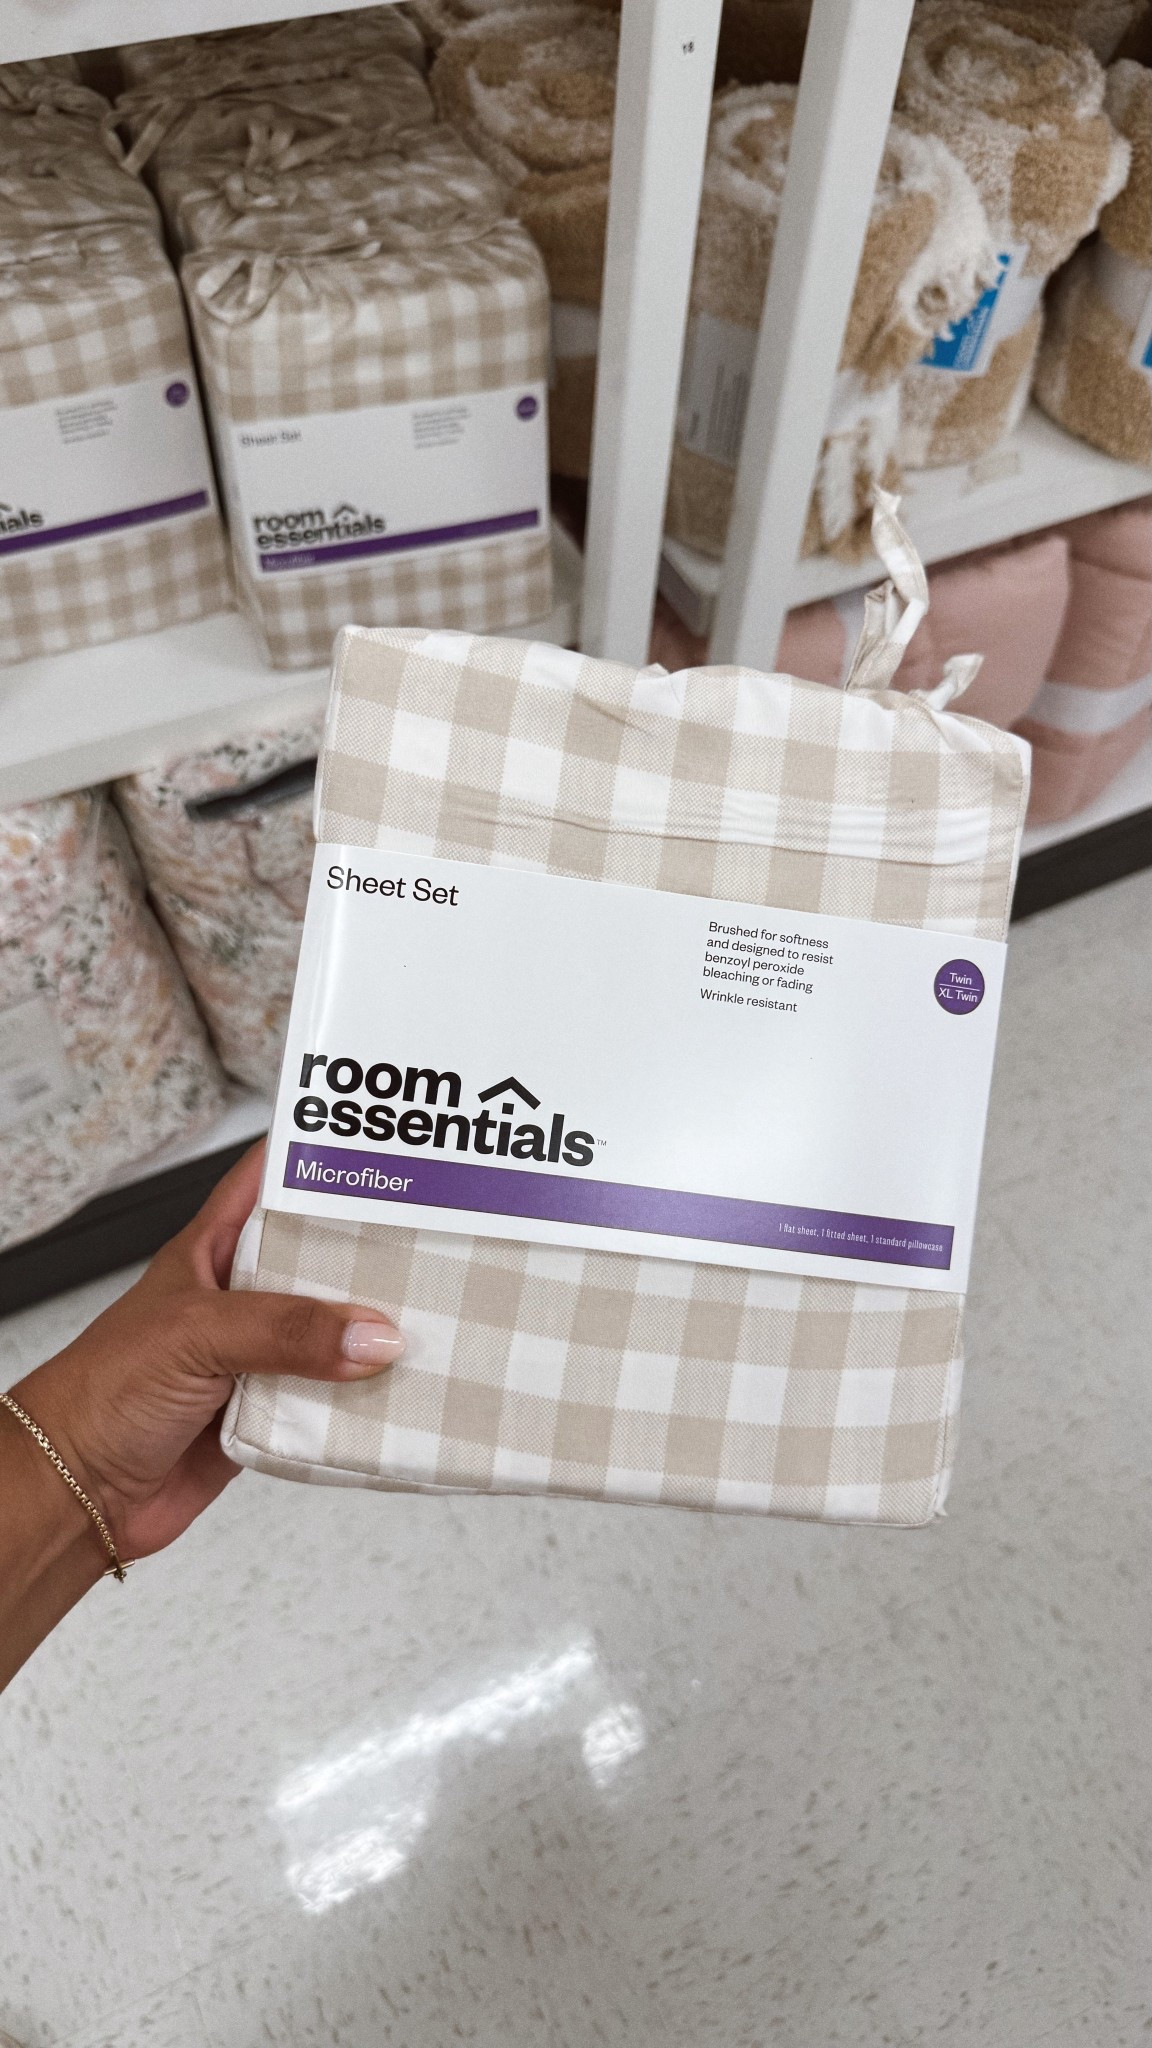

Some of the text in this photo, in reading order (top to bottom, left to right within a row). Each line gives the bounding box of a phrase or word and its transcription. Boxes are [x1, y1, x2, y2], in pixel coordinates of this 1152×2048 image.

[254, 509, 325, 533] room
[257, 514, 386, 549] essentials
[326, 866, 459, 906] Sheet Set
[708, 921, 829, 949] Brushed for softness
[704, 951, 805, 976] benzoyl peroxide
[706, 938, 834, 965] and designed to resist
[702, 966, 814, 994] bleaching or fading
[949, 972, 972, 985] Twin
[700, 988, 798, 1013] Wrinkle resistant
[938, 987, 978, 1003] XL Twin
[298, 1052, 462, 1108] room
[293, 1095, 595, 1167] essentials
[295, 1159, 413, 1193] Microfiber
[783, 1222, 796, 1234] flat
[826, 1228, 846, 1240] fitted
[875, 1236, 907, 1248] standard
[907, 1240, 943, 1252] pillowcase
